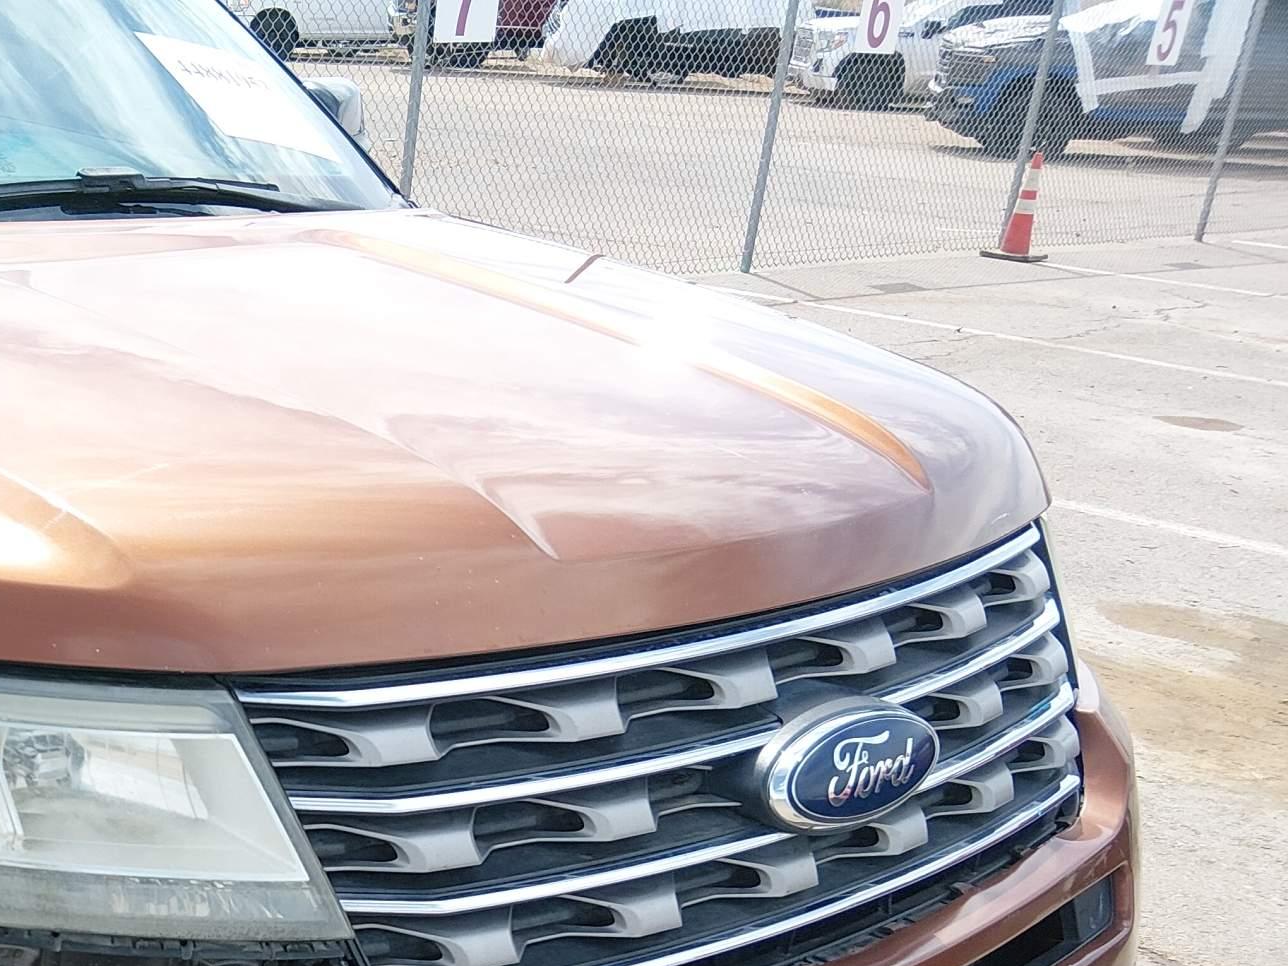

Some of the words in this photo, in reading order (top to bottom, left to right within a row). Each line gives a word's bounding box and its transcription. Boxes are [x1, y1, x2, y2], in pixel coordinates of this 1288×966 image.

[866, 0, 891, 49] 6
[1156, 0, 1186, 62] 5
[826, 729, 915, 807] Ford
